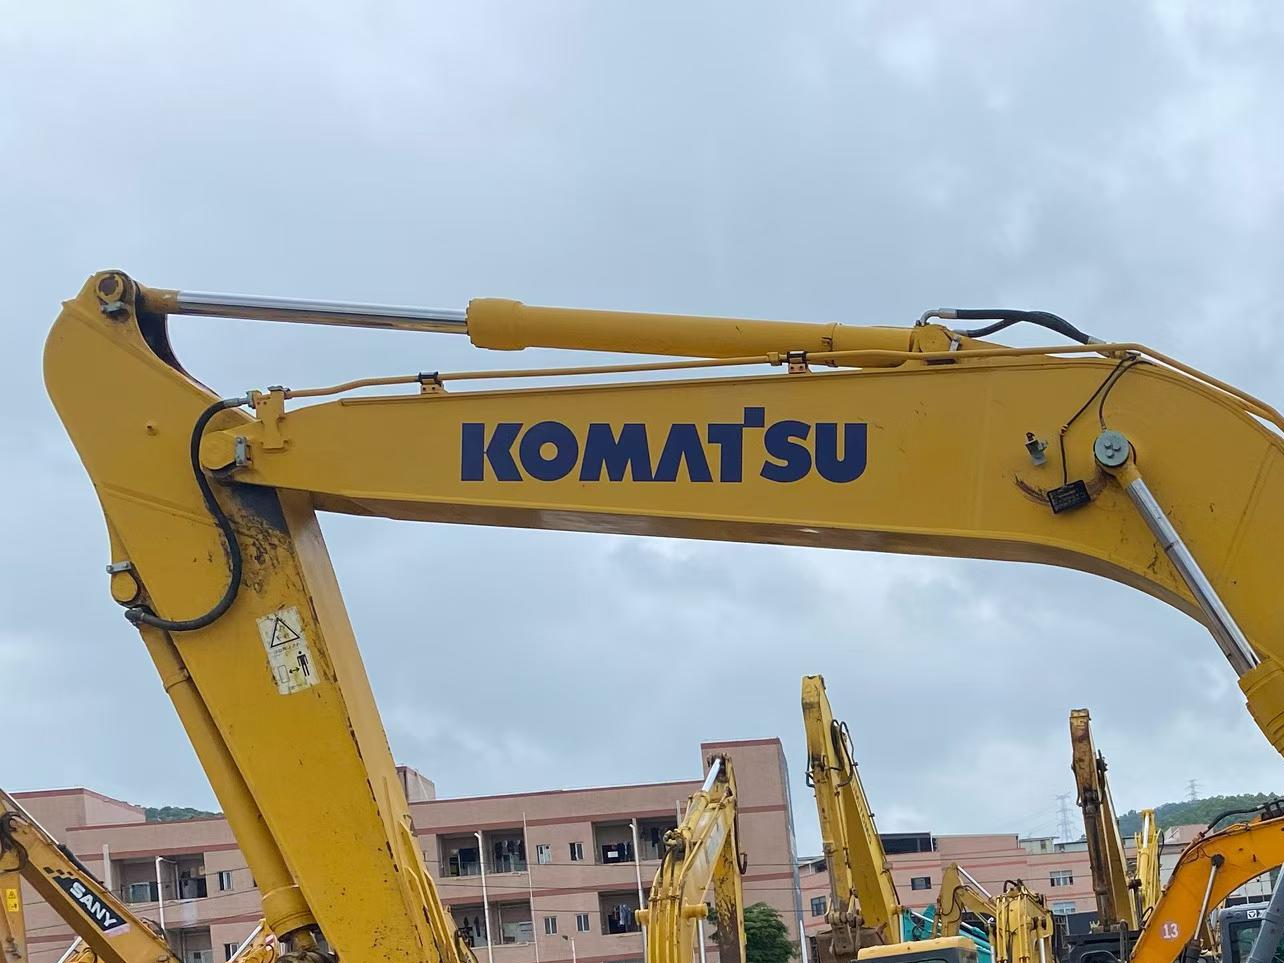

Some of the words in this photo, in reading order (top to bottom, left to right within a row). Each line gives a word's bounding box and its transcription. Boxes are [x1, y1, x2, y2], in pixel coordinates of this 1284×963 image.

[461, 407, 868, 483] KOMATSU
[70, 881, 117, 928] SANY
[1163, 923, 1179, 939] 13
